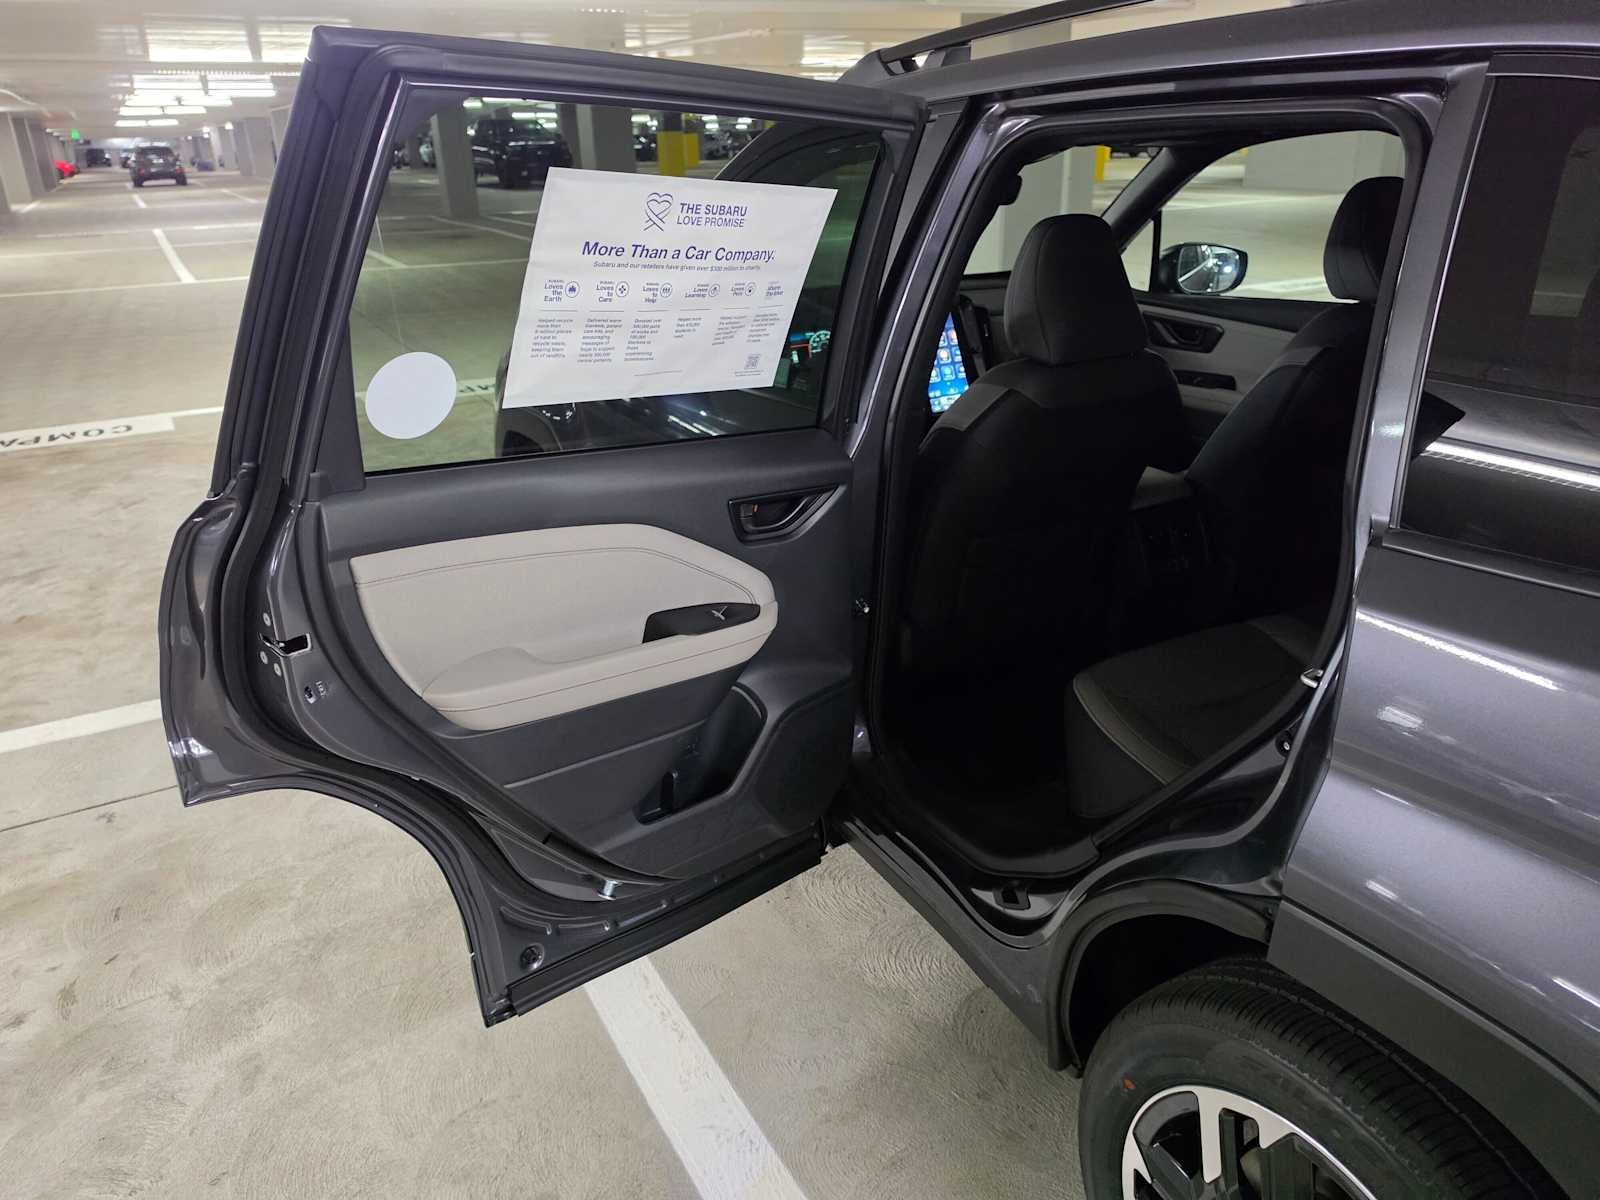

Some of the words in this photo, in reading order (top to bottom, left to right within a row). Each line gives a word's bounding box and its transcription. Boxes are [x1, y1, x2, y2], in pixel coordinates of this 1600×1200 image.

[679, 203, 701, 215] THE
[704, 205, 748, 217] SUBARU
[676, 215, 702, 226] LOVE
[704, 216, 745, 228] PROMISE
[582, 241, 625, 257] More
[631, 244, 668, 260] Than
[671, 249, 680, 260] a
[685, 246, 711, 261] Car
[714, 247, 775, 263] Company.
[593, 260, 616, 268] Subaru
[616, 261, 629, 269] and
[640, 262, 665, 270] retailers
[665, 263, 680, 271] have
[680, 264, 696, 273] given
[543, 295, 563, 303] Earth
[0, 424, 133, 448] COMPA
